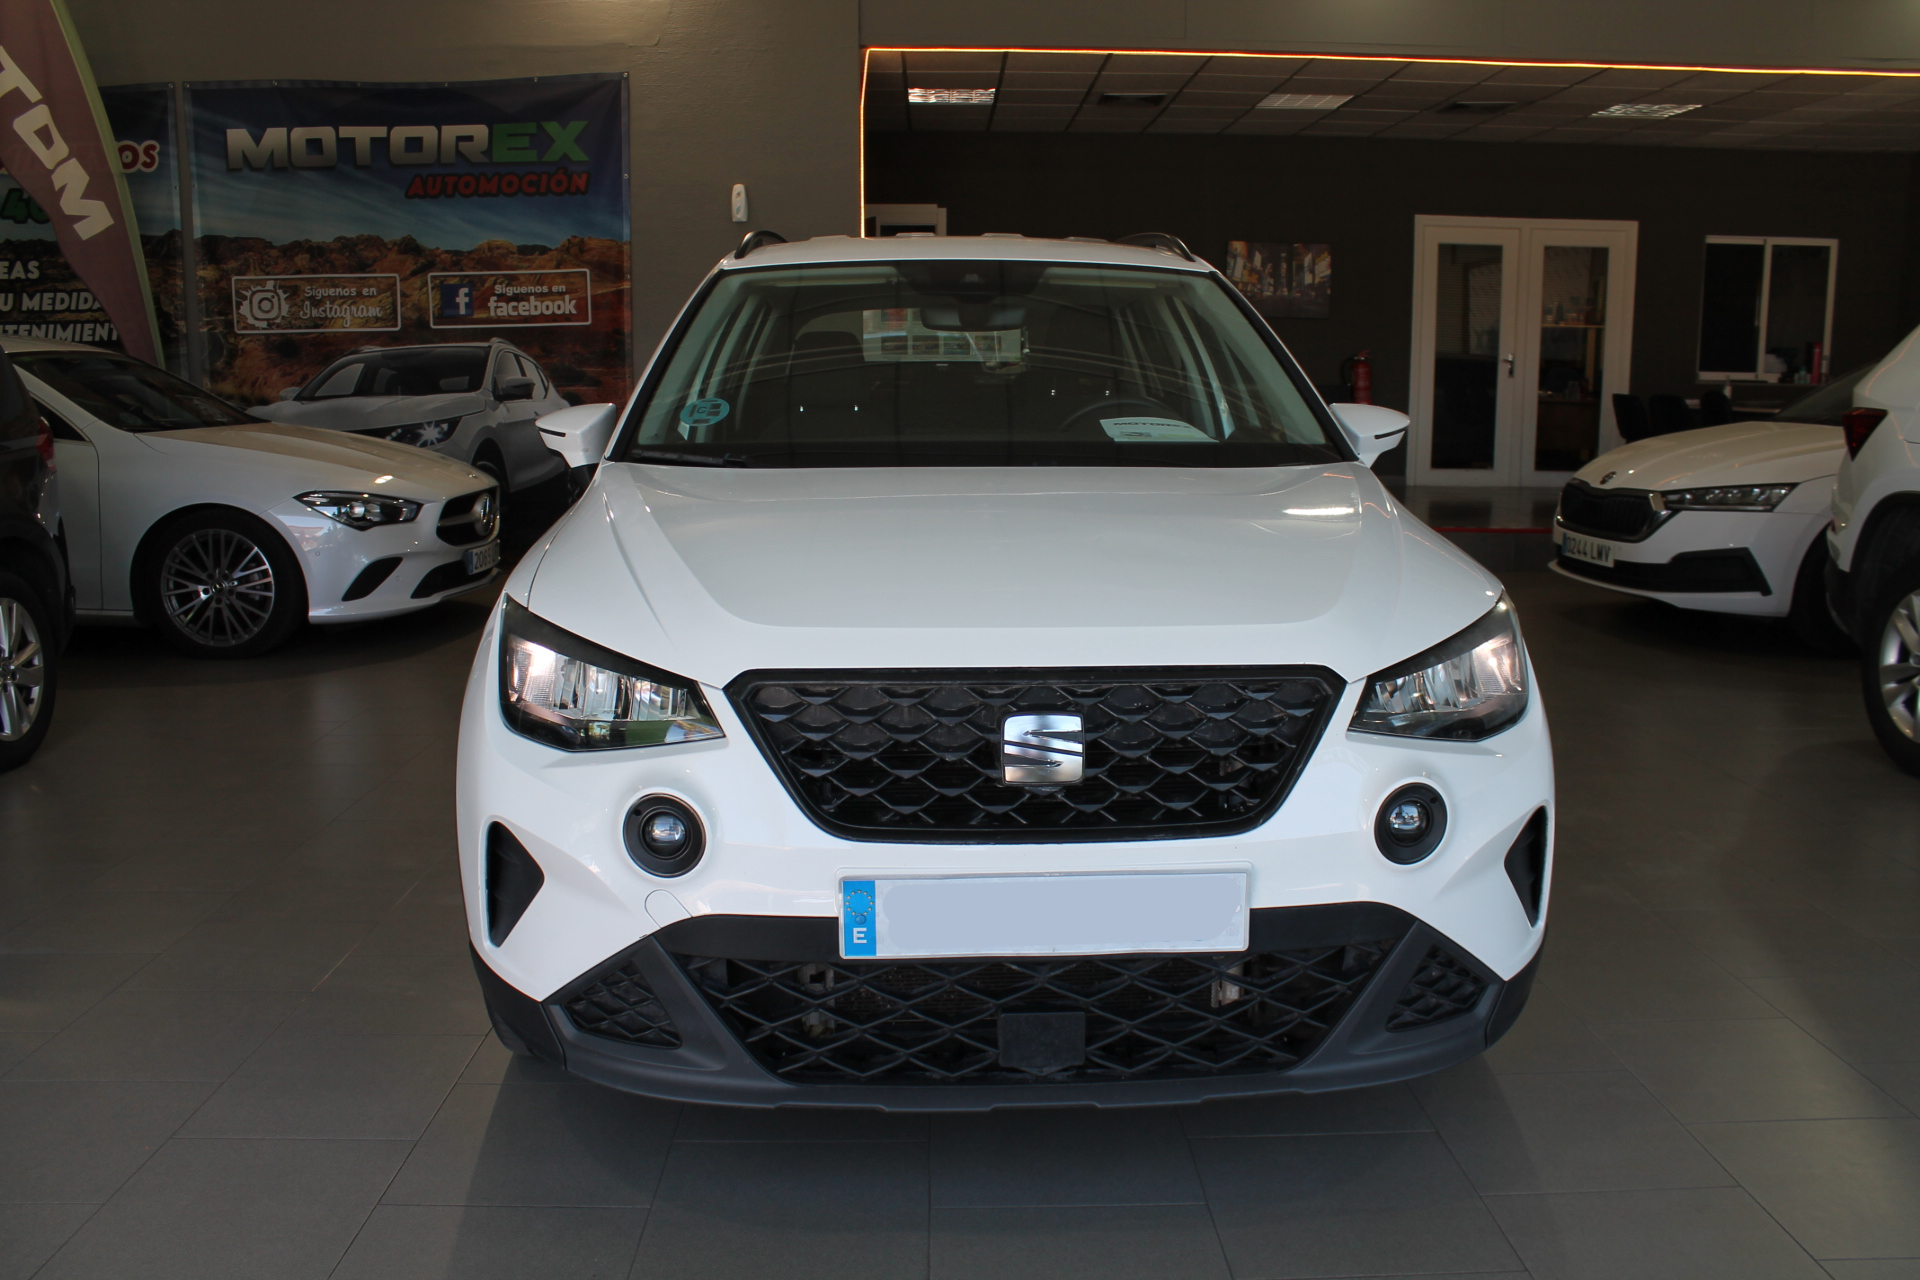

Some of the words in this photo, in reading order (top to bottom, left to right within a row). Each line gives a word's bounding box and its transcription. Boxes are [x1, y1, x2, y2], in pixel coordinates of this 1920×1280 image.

[226, 120, 590, 170] MOTOREX
[406, 168, 590, 199] AUTOMOCIÓN
[362, 287, 377, 296] en
[551, 284, 566, 293] en
[300, 301, 383, 327] Instagram
[487, 294, 577, 317] facebook
[852, 927, 868, 943] E
